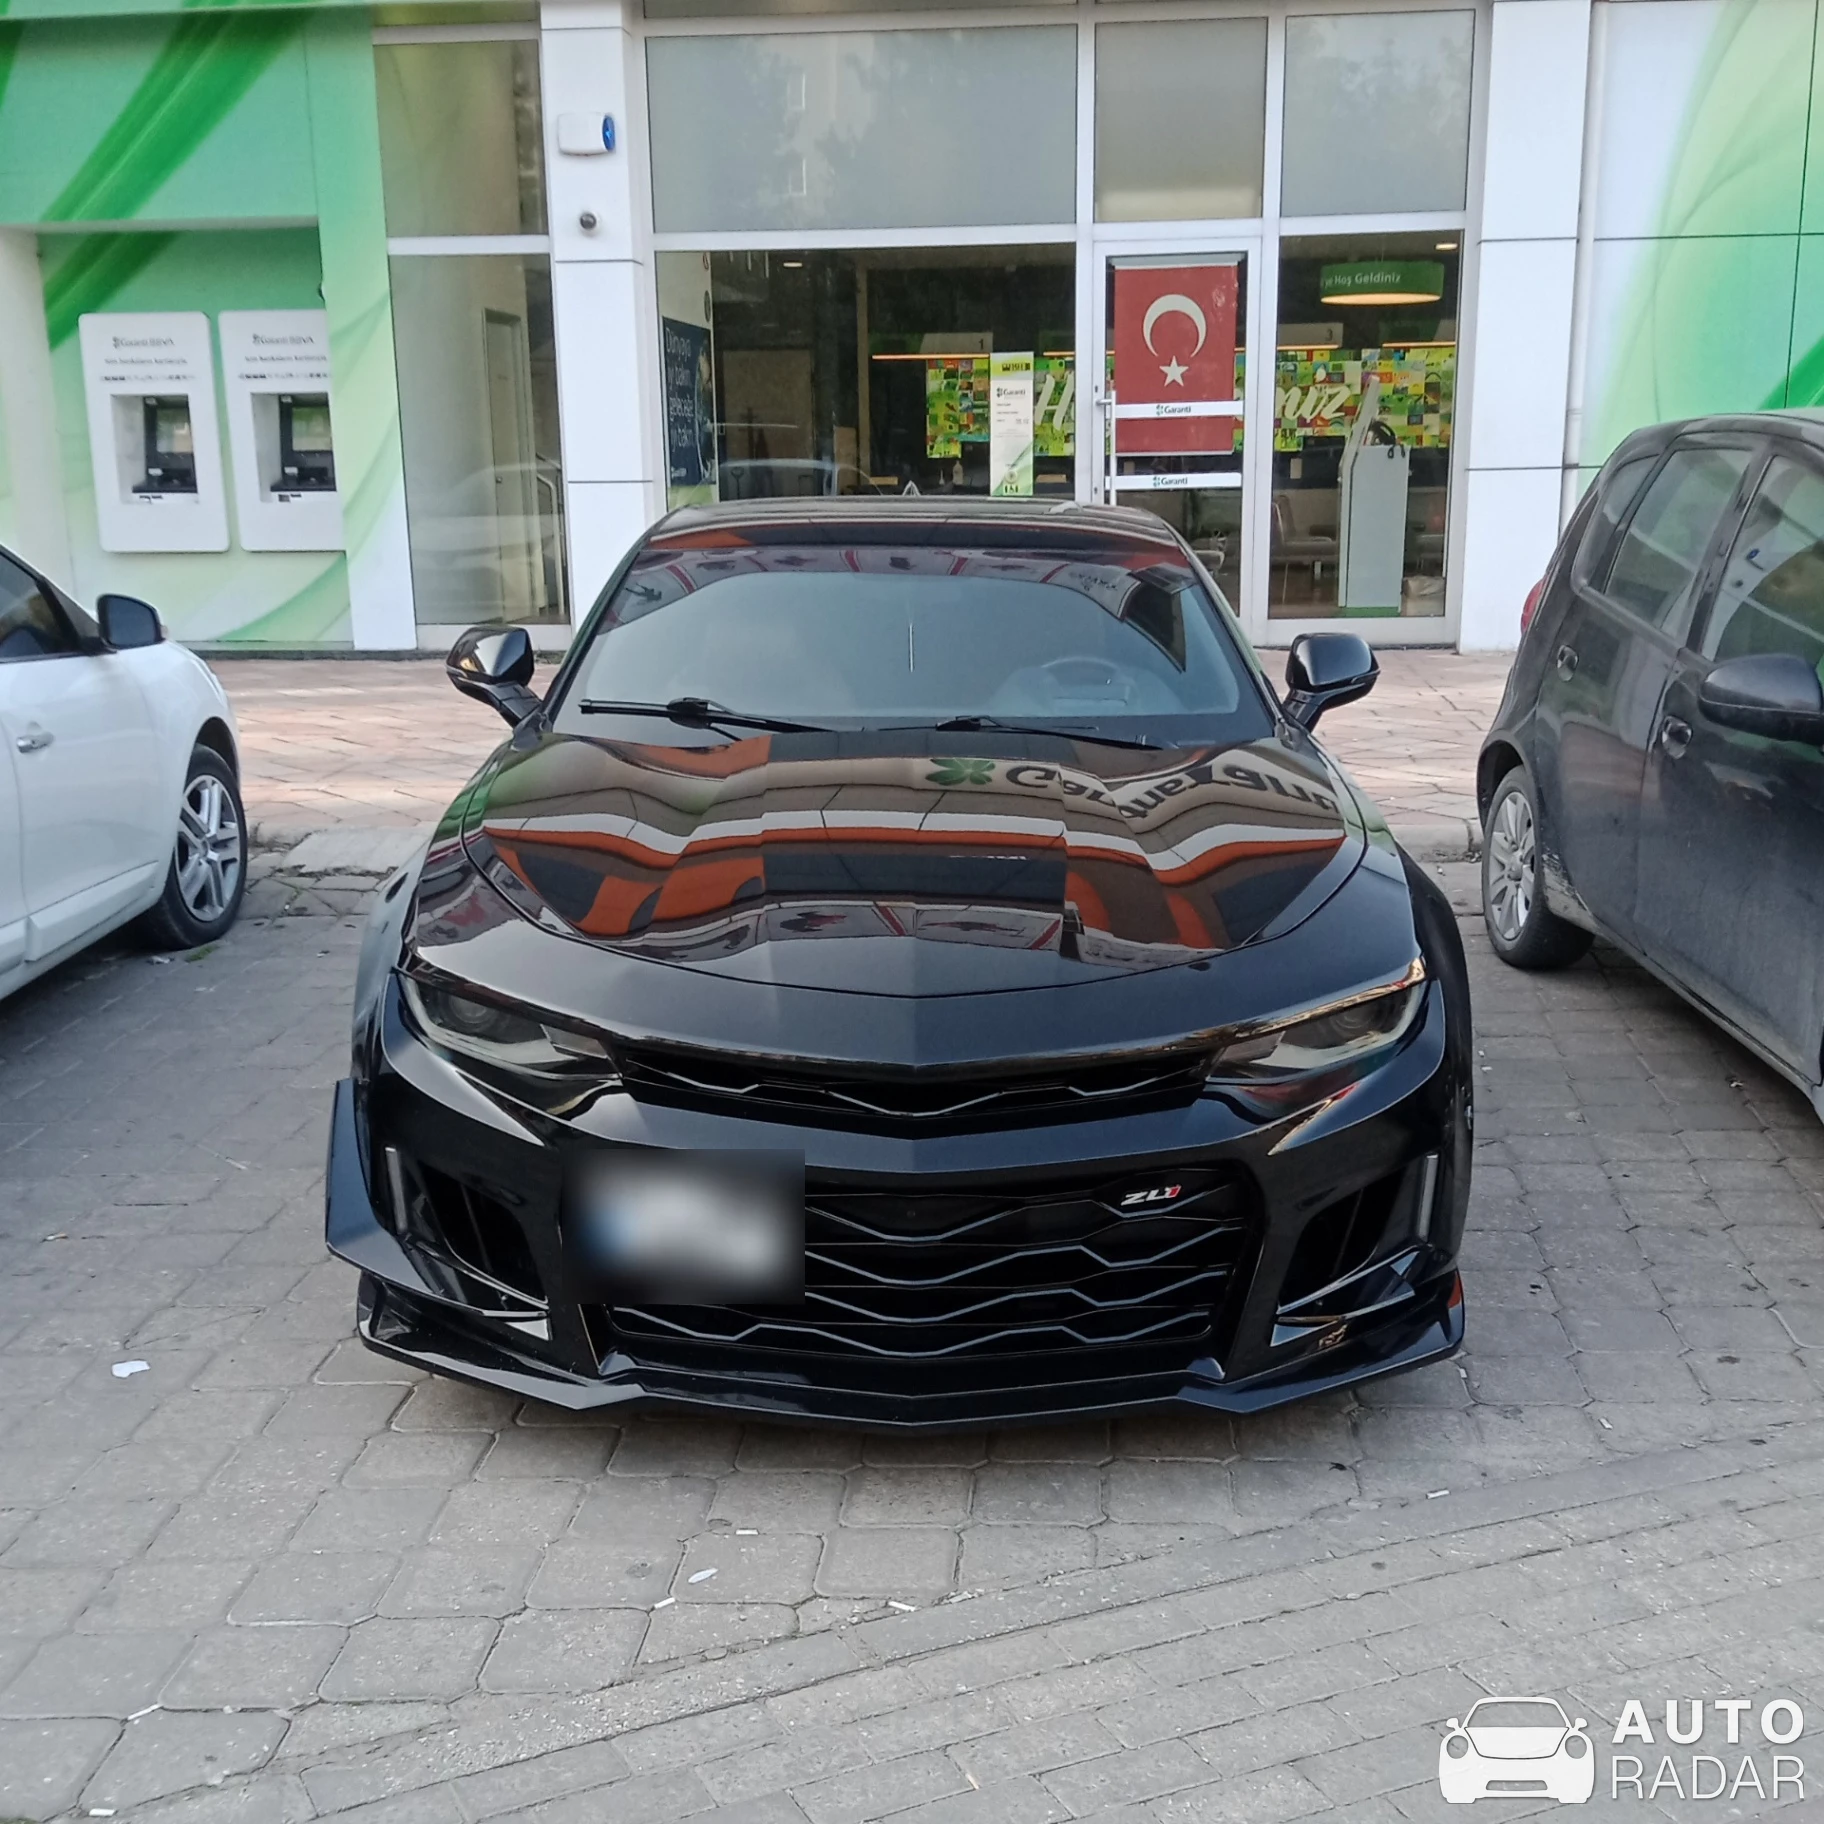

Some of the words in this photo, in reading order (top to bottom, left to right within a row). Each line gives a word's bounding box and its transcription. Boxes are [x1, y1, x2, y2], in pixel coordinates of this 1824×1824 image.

[1334, 275, 1352, 287] Hoş
[1355, 271, 1401, 285] Geldiniz
[978, 338, 984, 350] 1
[1163, 405, 1192, 415] Garanti
[1160, 477, 1188, 486] Garanti
[1121, 1185, 1182, 1206] ZL1
